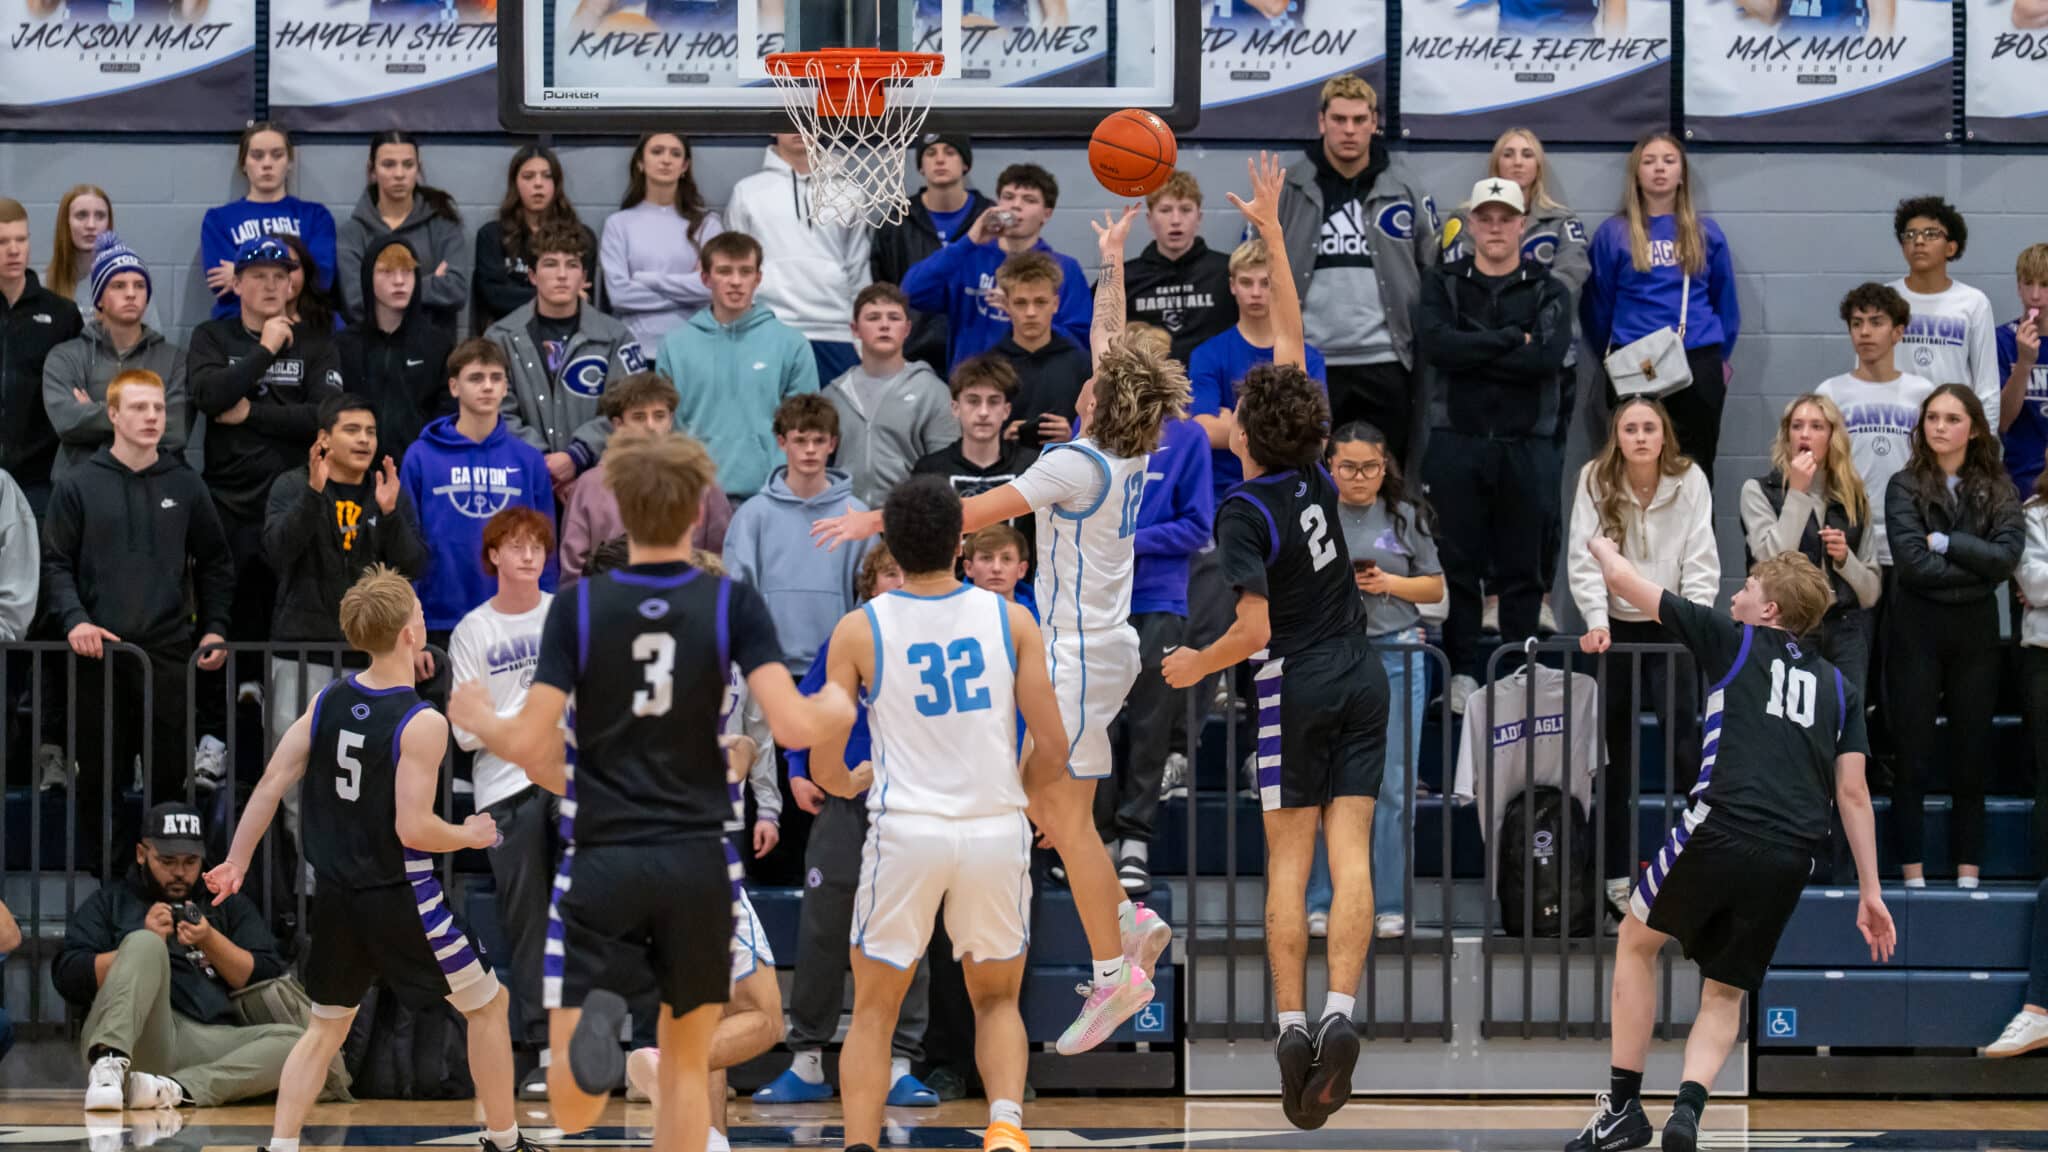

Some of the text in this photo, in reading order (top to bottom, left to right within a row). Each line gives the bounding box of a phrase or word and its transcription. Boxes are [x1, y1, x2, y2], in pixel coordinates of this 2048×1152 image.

[12, 22, 232, 50] JACKSON MAST
[275, 21, 405, 50] HAYDEN
[568, 30, 681, 60] KADEN
[1003, 25, 1098, 56] JONES
[1241, 28, 1357, 59] MACON
[1405, 36, 1668, 62] MICHAEL FLETCHER
[1726, 34, 1908, 62] MAX MACON
[231, 218, 262, 246] LADY
[450, 466, 507, 487] CANYON
[1118, 470, 1144, 539] 12
[1299, 503, 1338, 573] 2
[632, 631, 676, 718] 3
[906, 636, 992, 717] 32
[1765, 657, 1817, 729] 10
[335, 728, 367, 802] 5
[163, 813, 201, 836] ATR
